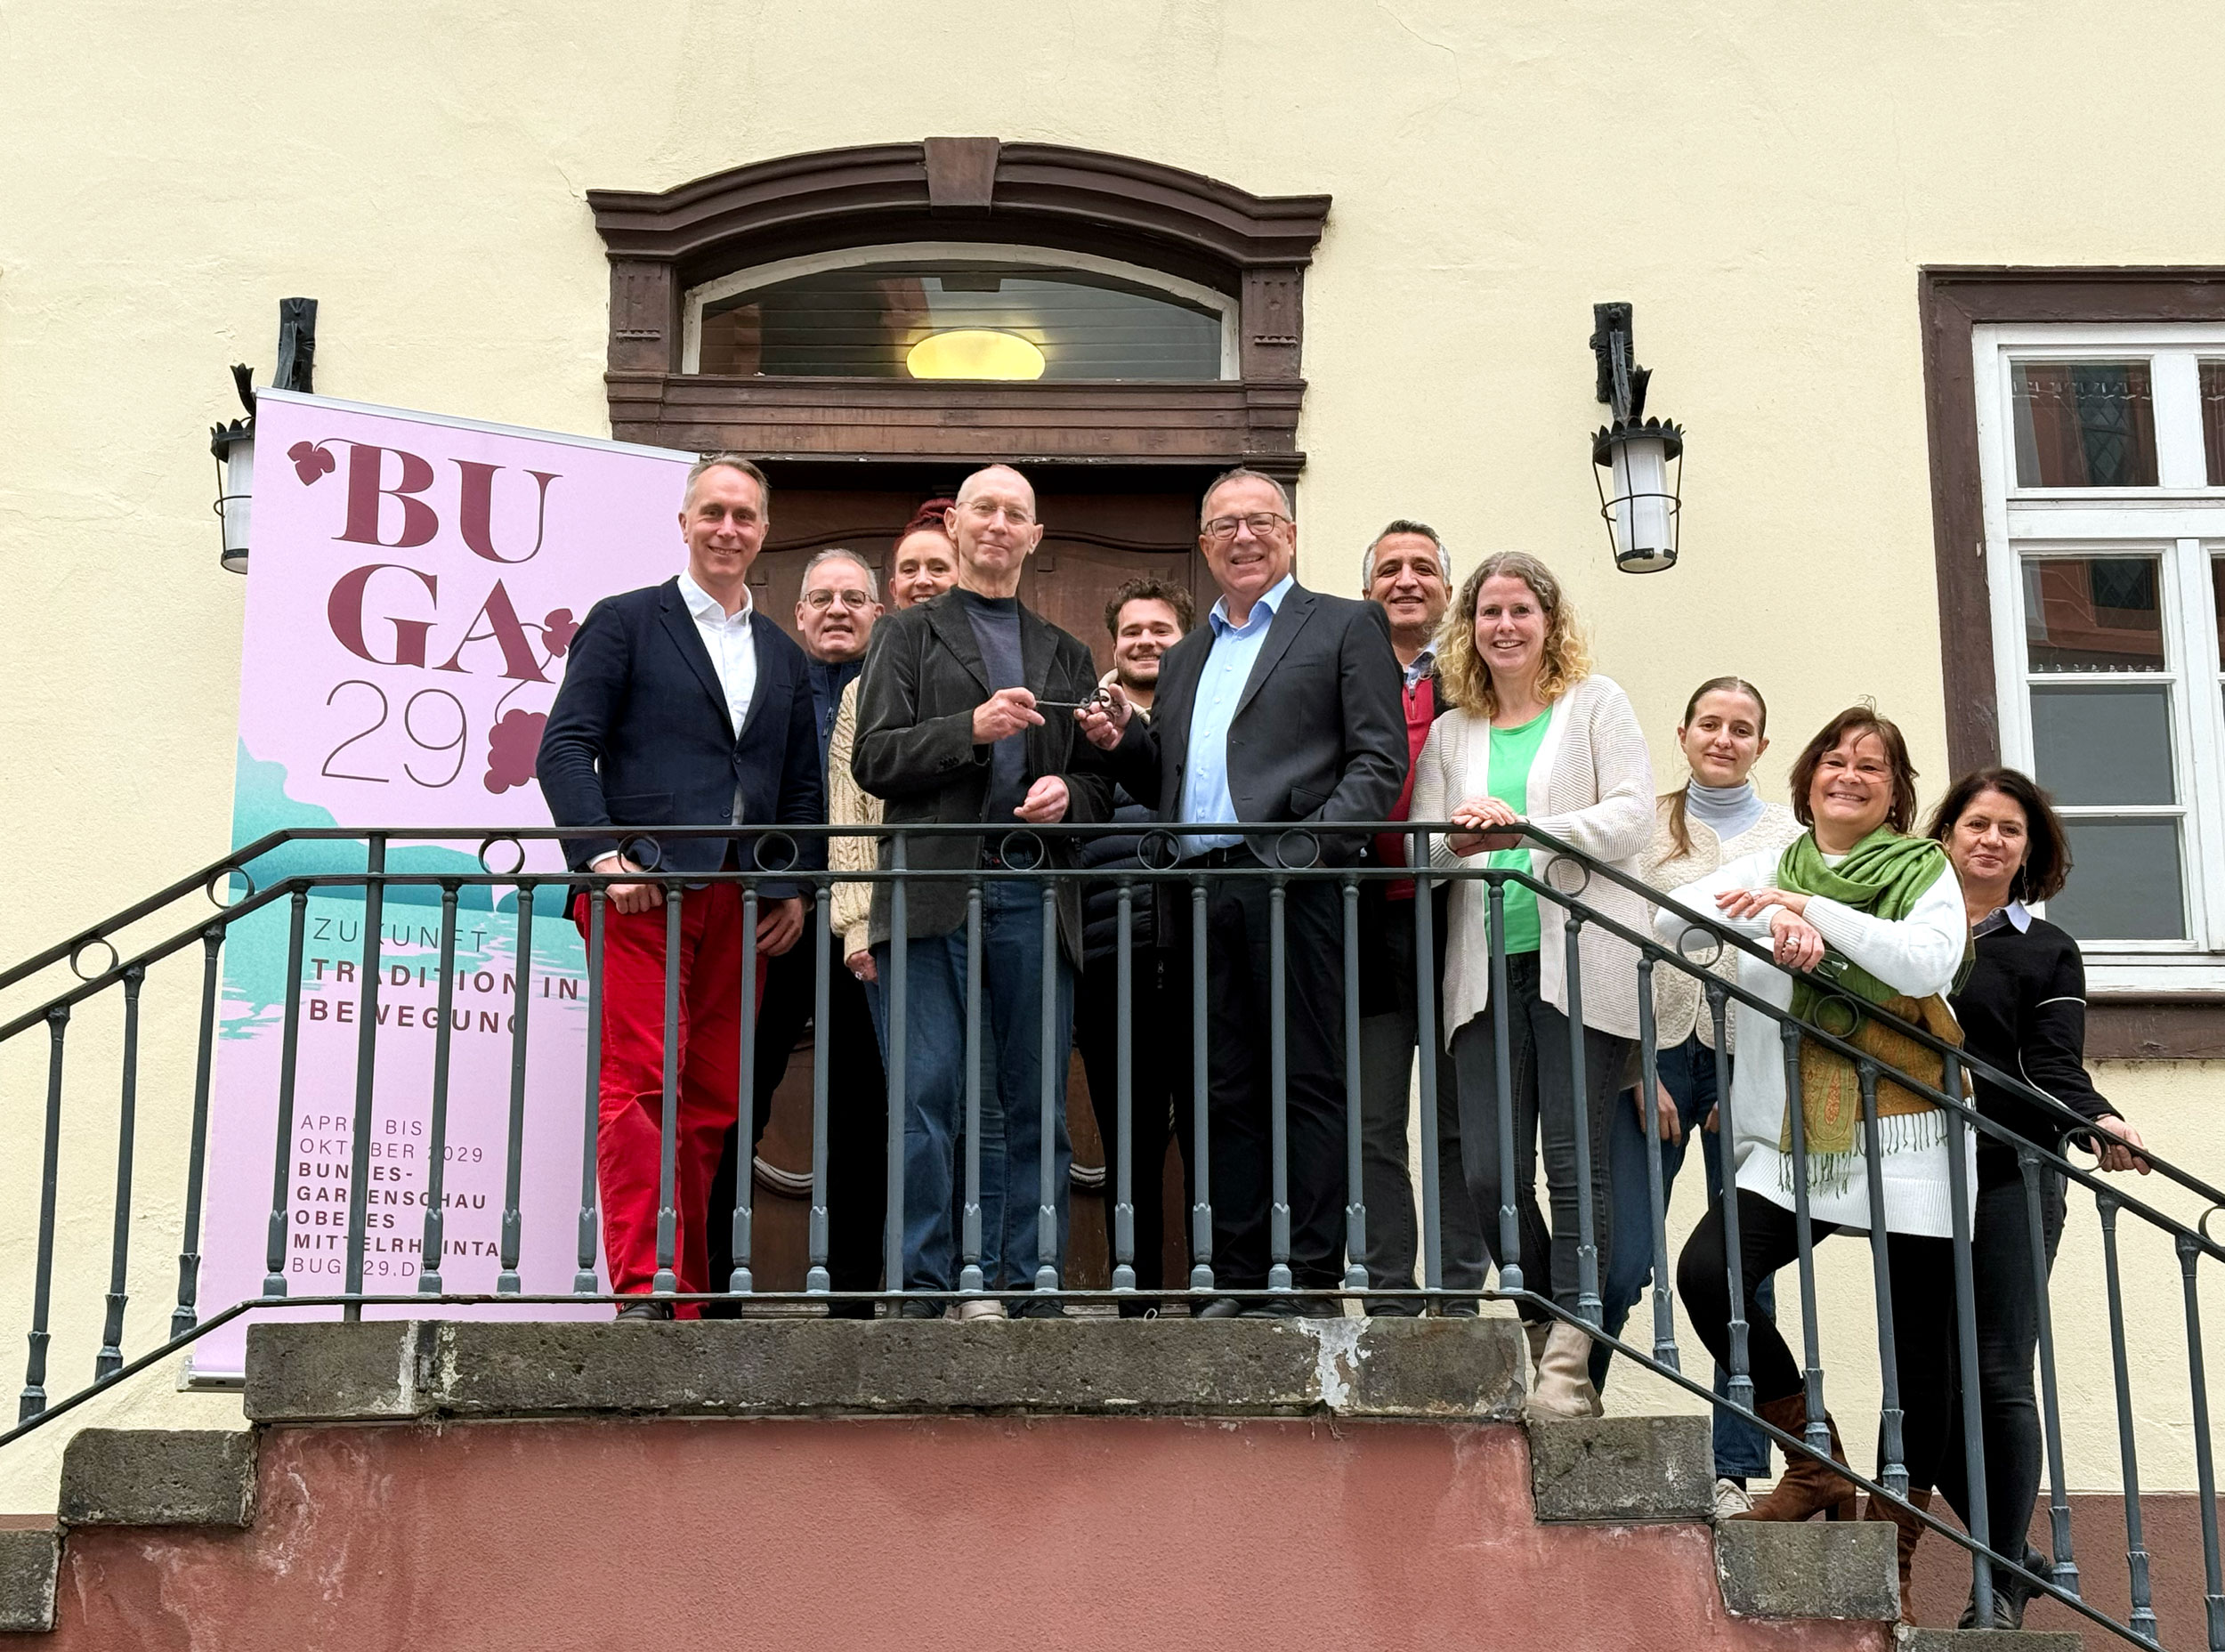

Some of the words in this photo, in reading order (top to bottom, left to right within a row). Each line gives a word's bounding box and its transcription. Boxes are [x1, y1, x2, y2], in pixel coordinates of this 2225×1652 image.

[331, 441, 564, 563] BU
[327, 563, 556, 684] GA
[321, 679, 467, 788] 29
[311, 958, 517, 994] TRDIION
[544, 976, 578, 1000] IN
[385, 1119, 423, 1136] BIS
[300, 1138, 415, 1160] OKTBER
[298, 1162, 413, 1182] BUNES-
[296, 1186, 486, 1210] GARENSCHAU
[295, 1210, 395, 1229] OBEES
[292, 1257, 425, 1277] BUG29.D
